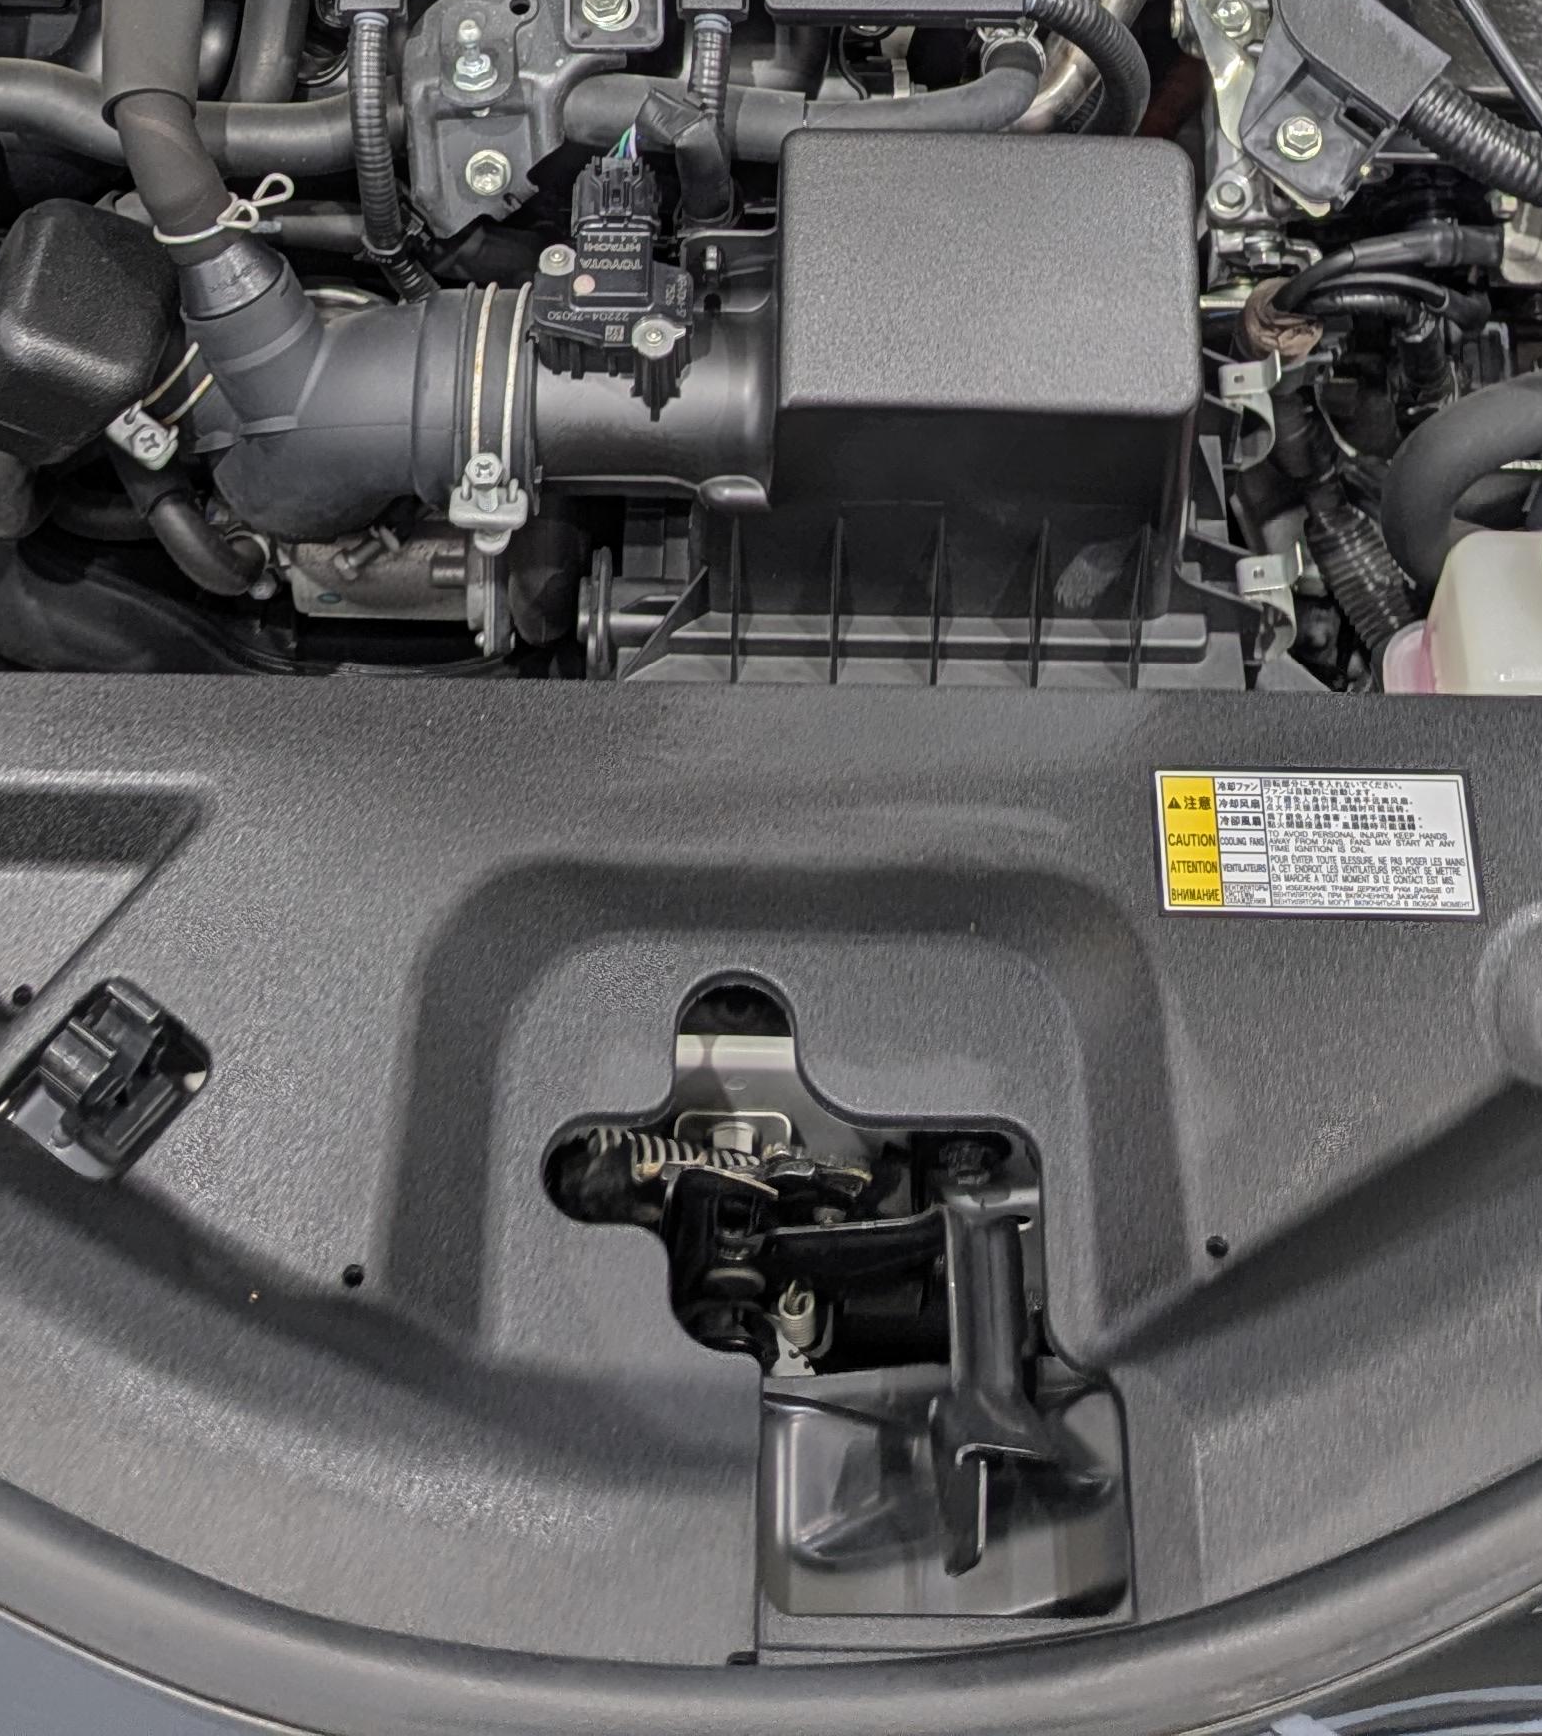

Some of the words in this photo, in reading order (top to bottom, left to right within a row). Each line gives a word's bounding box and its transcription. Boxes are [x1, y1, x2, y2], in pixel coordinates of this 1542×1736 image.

[584, 243, 641, 253] HITACHI
[580, 258, 643, 271] TOYOTA
[1217, 781, 1259, 792] 冷却ファン
[1184, 795, 1212, 811] 注意
[1168, 833, 1217, 847] CAUTION
[1220, 837, 1247, 846] COOLING
[1250, 837, 1265, 846] FANS
[1295, 845, 1333, 853] IGNITION
[1270, 855, 1288, 863] POUR
[1316, 856, 1337, 864] TOUTE
[1378, 856, 1387, 864] NE
[1390, 857, 1403, 865] PAS
[1405, 857, 1427, 865] POSER
[1431, 857, 1442, 866] LES
[1445, 857, 1466, 866] MAINS
[1170, 860, 1218, 874] ATTENTION
[1223, 864, 1267, 873] VENTILATEURS
[1279, 864, 1291, 873] CET
[1327, 865, 1338, 873] LES
[1341, 865, 1388, 874] VENTILATEURS
[1391, 866, 1420, 874] PEUVENT
[1424, 866, 1432, 875] SE
[1436, 866, 1461, 876] METTRE
[1284, 874, 1310, 882] MARCHE
[1322, 874, 1338, 882] TOUT
[1342, 875, 1369, 883] MOMENT
[1373, 875, 1379, 883] SI
[1383, 875, 1390, 883] LE
[1393, 875, 1423, 884] CONTACT
[1427, 876, 1438, 884] EST
[1171, 888, 1221, 901] ВНИМАНИЕ
